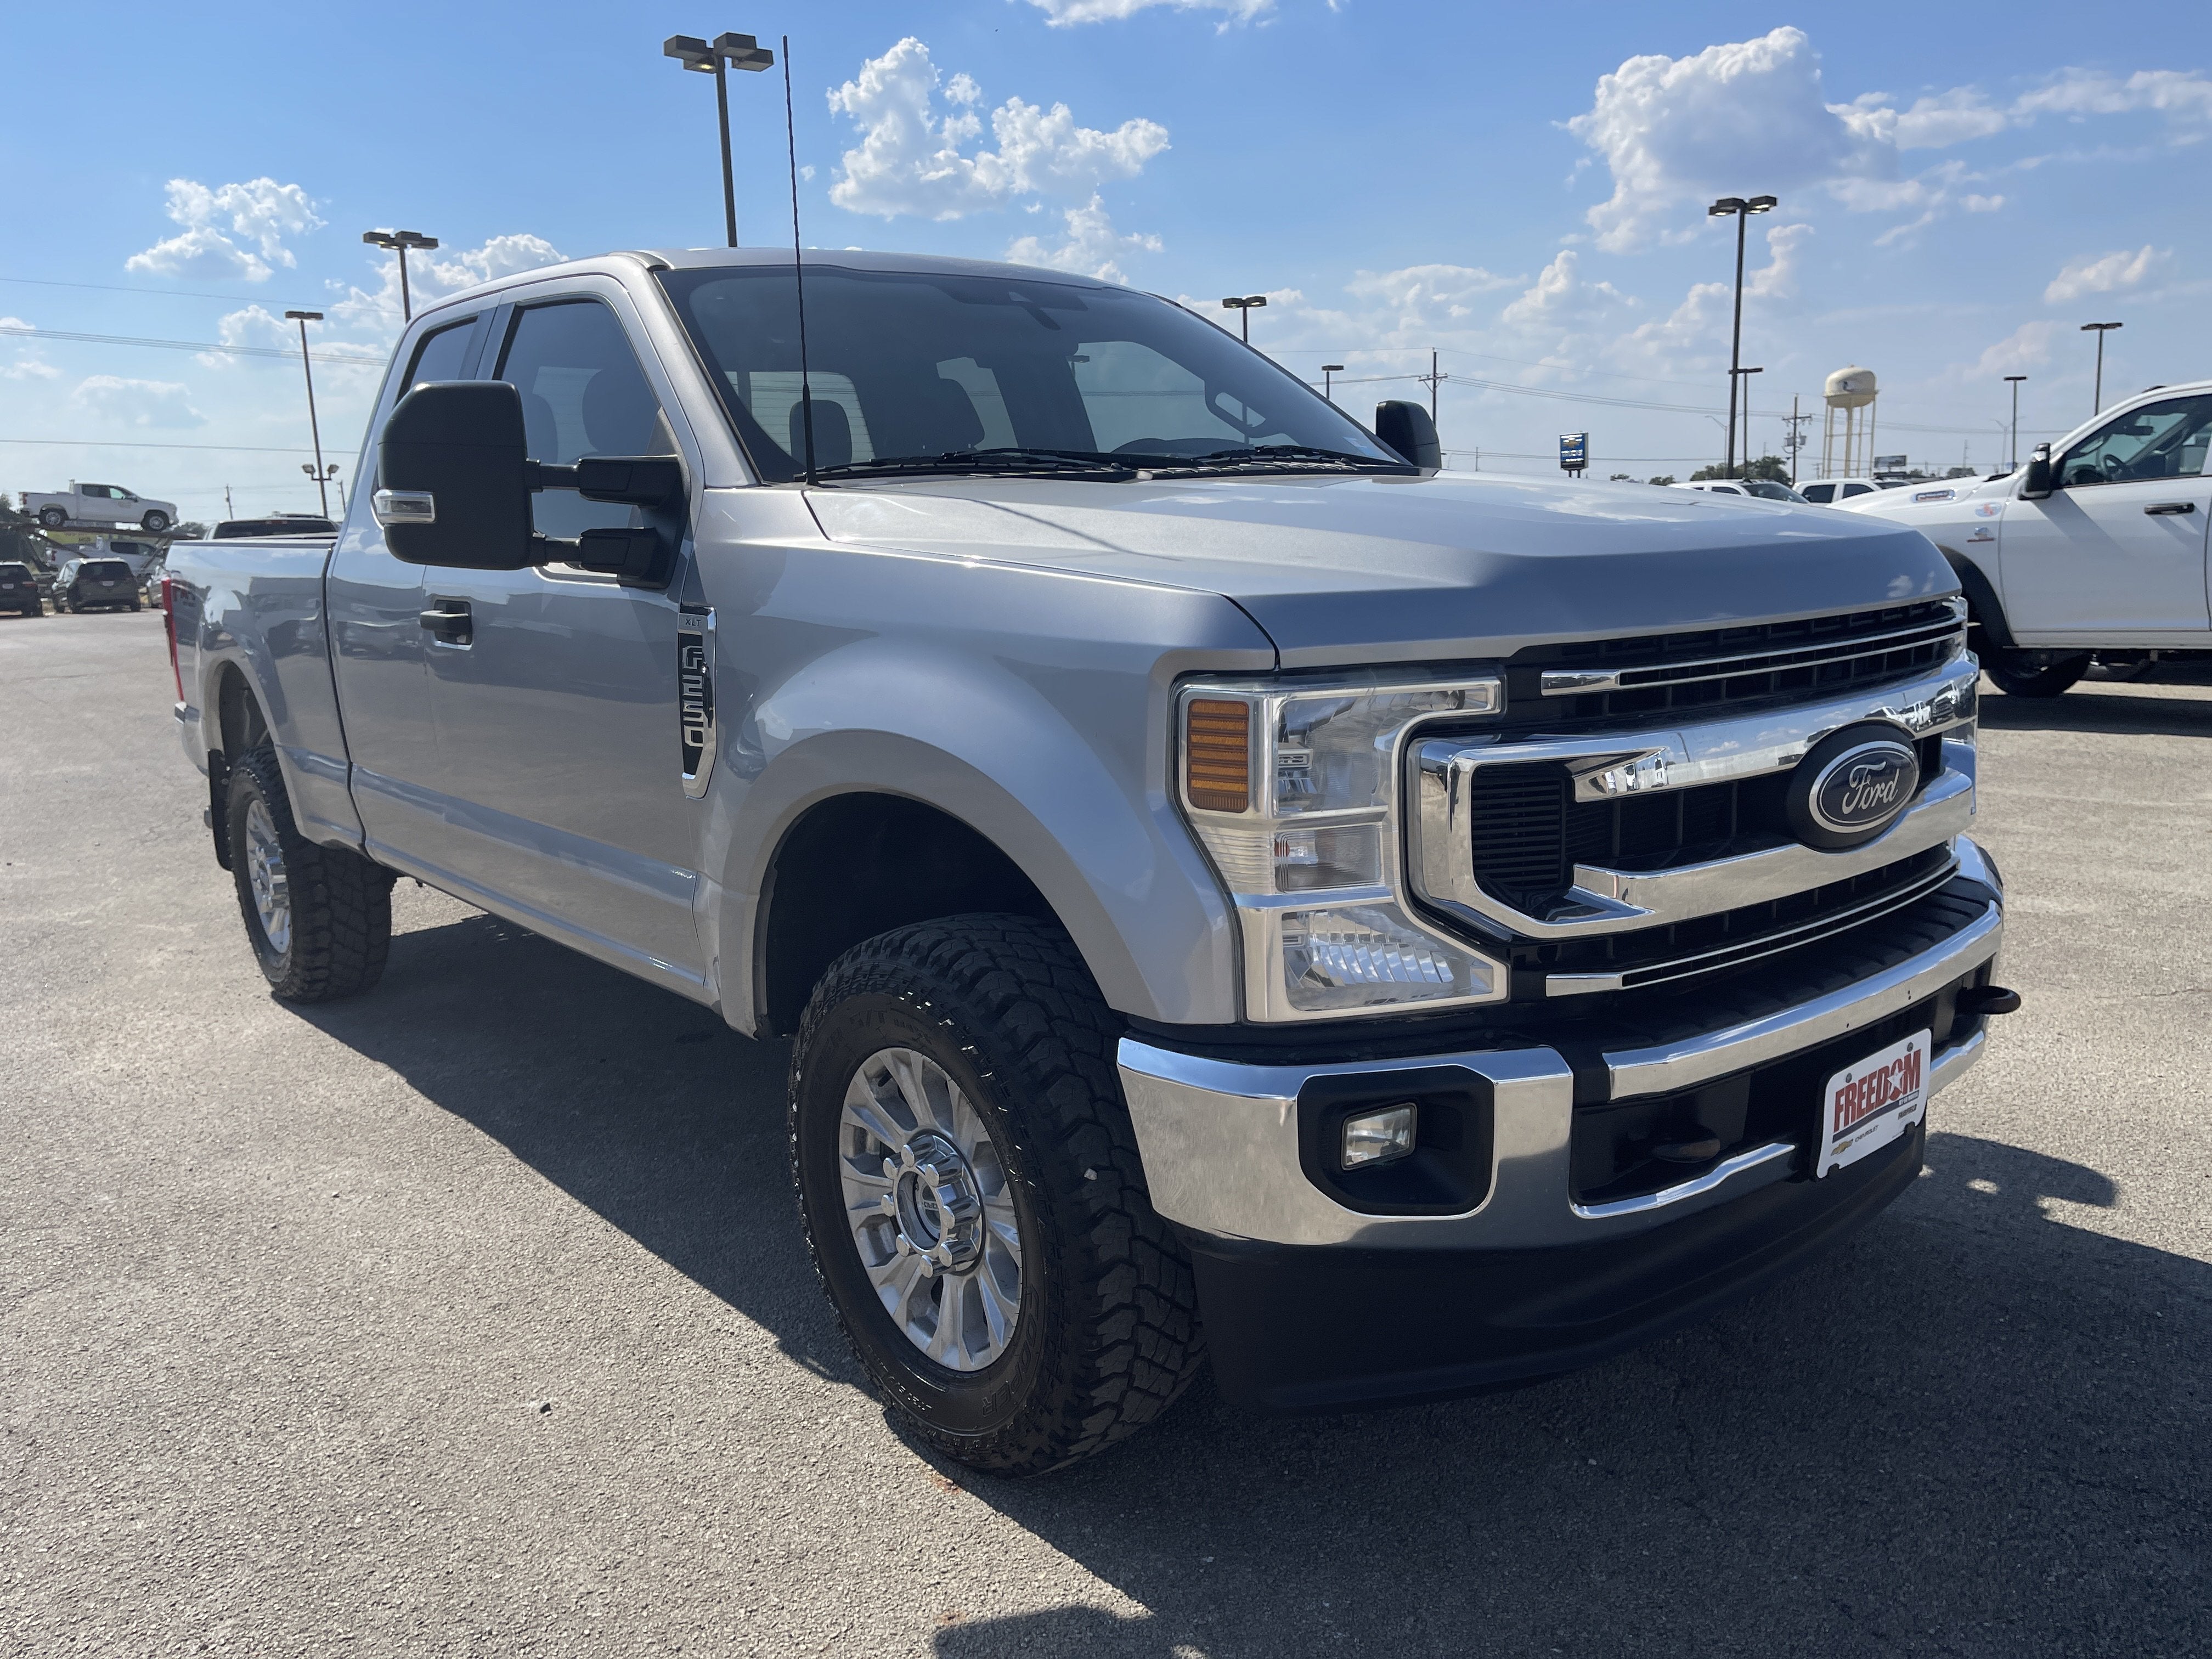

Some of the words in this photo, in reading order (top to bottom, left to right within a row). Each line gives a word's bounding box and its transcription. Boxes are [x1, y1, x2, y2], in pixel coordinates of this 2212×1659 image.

[1842, 761, 1900, 815] Ford
[1833, 1048, 1921, 1133] FREEDOM
[1855, 1125, 1879, 1142] CHEVROLET
[983, 1283, 1040, 1418] COOPER
